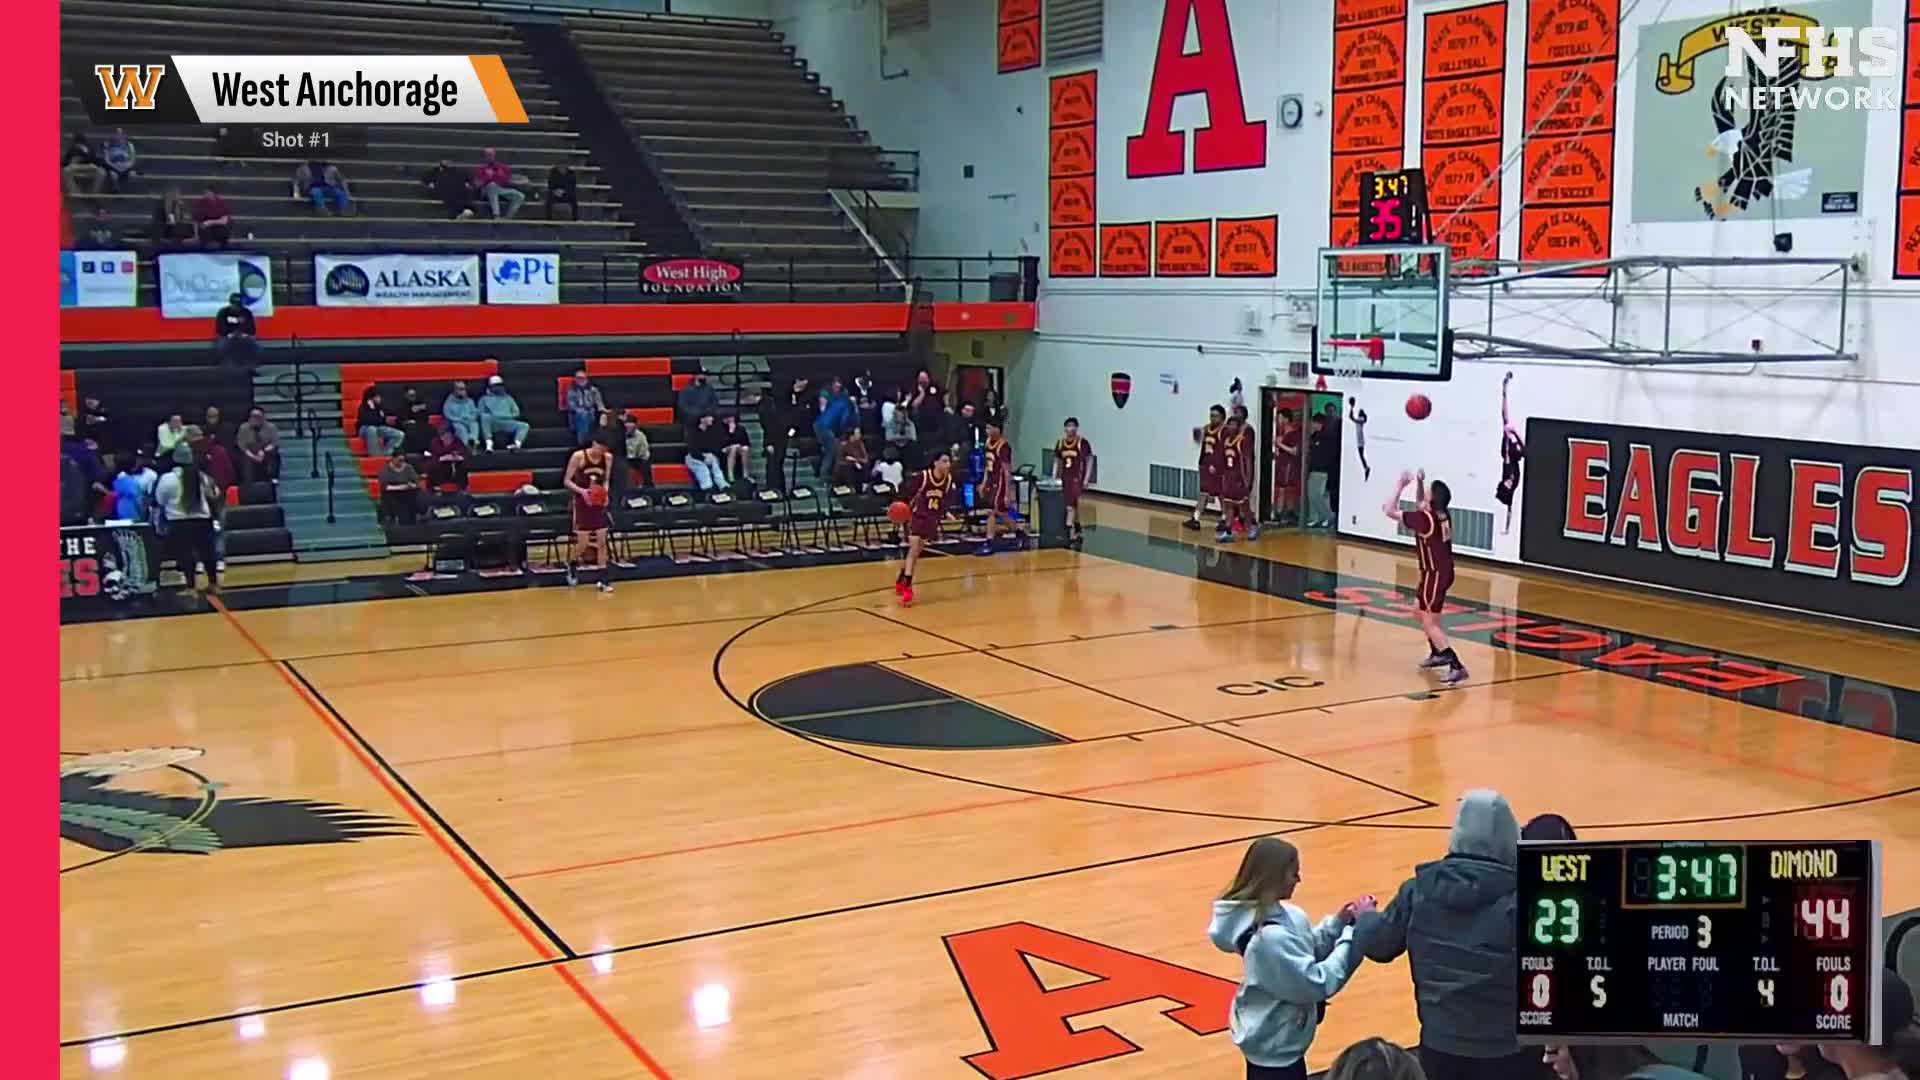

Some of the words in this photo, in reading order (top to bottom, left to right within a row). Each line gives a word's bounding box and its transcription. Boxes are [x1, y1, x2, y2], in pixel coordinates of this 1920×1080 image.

[1369, 198, 1402, 240] 35
[375, 269, 471, 288] ALASKA
[523, 257, 555, 285] Pt
[656, 265, 689, 279] West
[693, 265, 727, 282] High
[642, 282, 741, 293] FOUNDATION
[1563, 437, 1913, 586] EAGLES
[60, 536, 96, 556] HE
[1542, 854, 1591, 881] WEST
[1770, 849, 1838, 879] DIMOND
[1657, 853, 1737, 900] 3:47
[1534, 899, 1580, 944] 23
[1801, 898, 1850, 939] 44
[1651, 925, 1689, 940] PERIOD
[1696, 915, 1712, 949] 3
[1522, 957, 1553, 971] FOULS
[1648, 957, 1686, 971] PLAYER
[1692, 957, 1719, 971] FOUL
[1816, 957, 1851, 971] FOULS
[1758, 979, 1774, 1006] 4
[1520, 1012, 1552, 1025] SCORE
[1663, 1013, 1699, 1027] MATCH
[1815, 1015, 1851, 1029] SCORE
